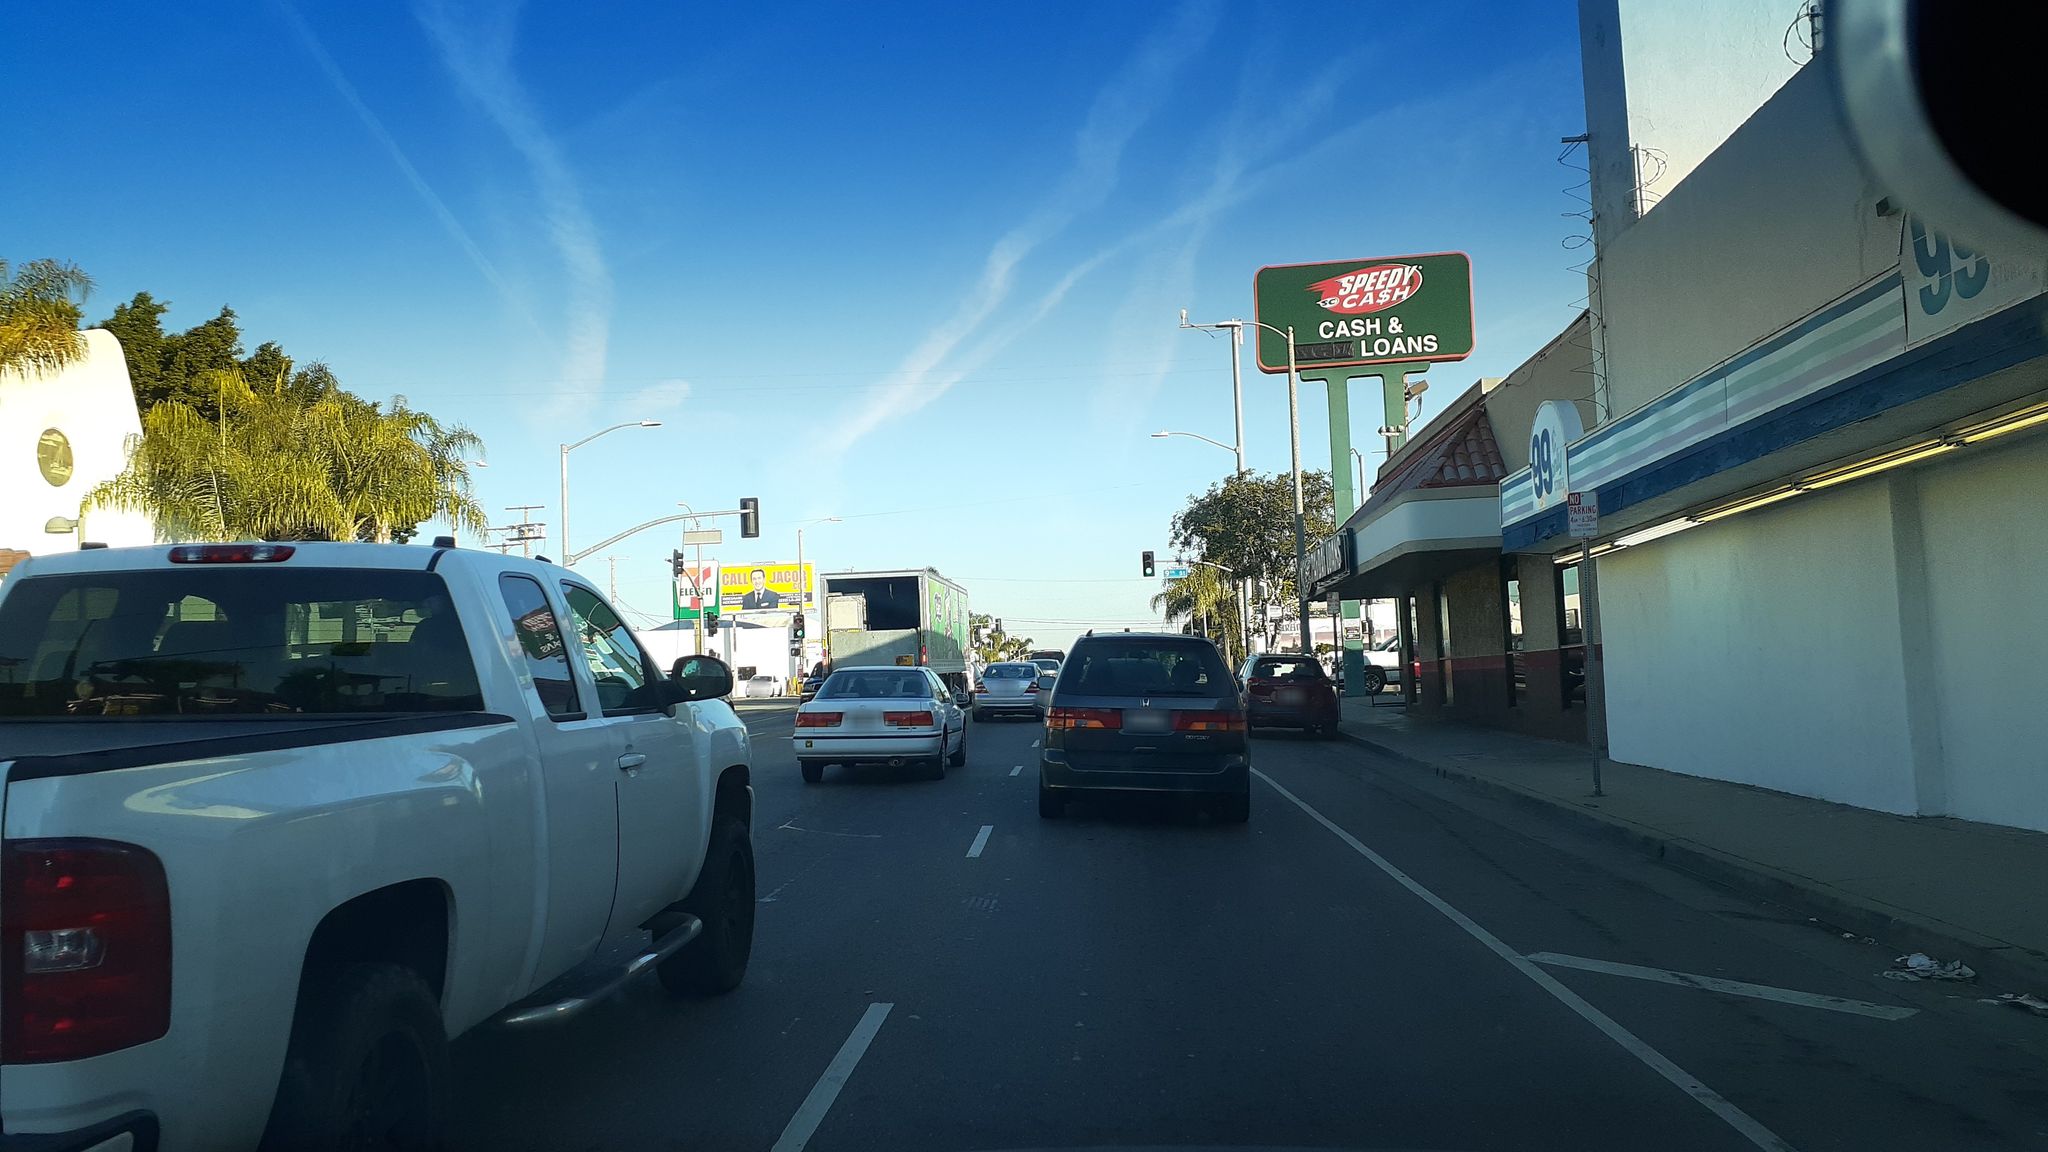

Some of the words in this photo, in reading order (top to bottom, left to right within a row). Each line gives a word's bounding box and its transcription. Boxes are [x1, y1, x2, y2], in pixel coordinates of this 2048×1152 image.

[1336, 265, 1418, 296] SPEEDY
[1321, 298, 1336, 307] SC
[1342, 286, 1411, 309] CA$H
[1318, 317, 1381, 339] CASH
[1388, 316, 1404, 334] &
[1360, 335, 1439, 357] LOANS
[1532, 428, 1553, 499] 99
[1569, 494, 1580, 505] NO
[1569, 504, 1597, 515] PARKING
[722, 573, 749, 585] CALL
[680, 587, 712, 596] ELEn
